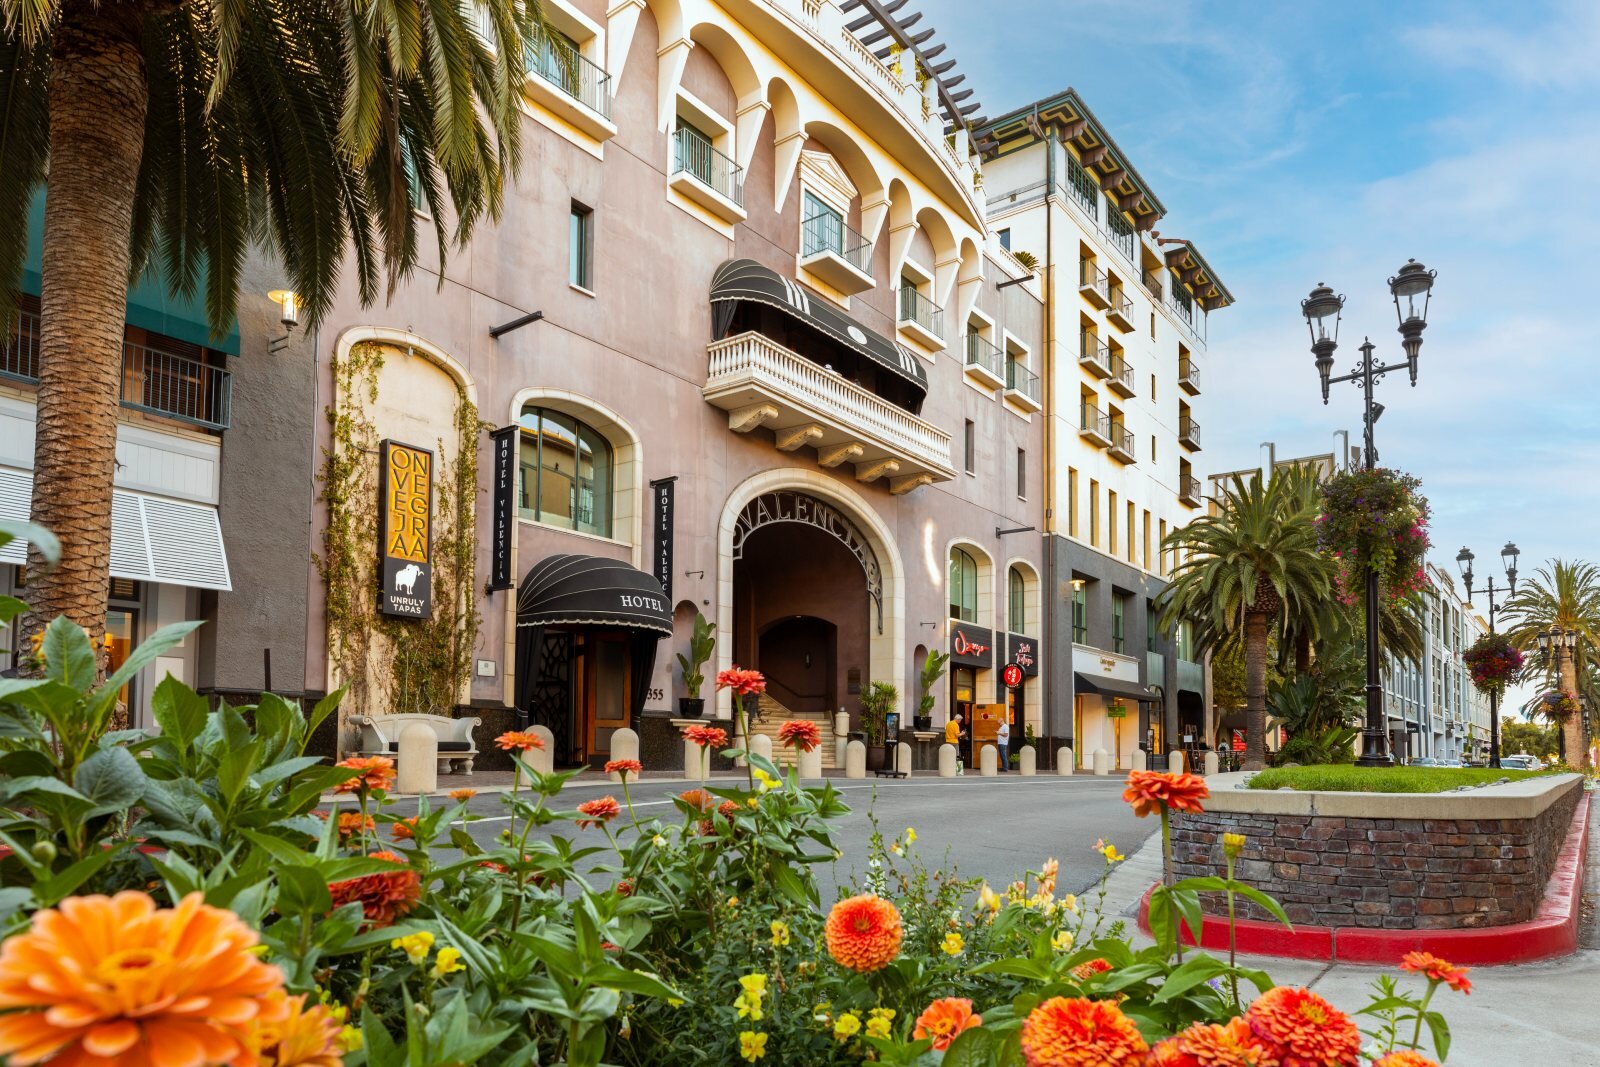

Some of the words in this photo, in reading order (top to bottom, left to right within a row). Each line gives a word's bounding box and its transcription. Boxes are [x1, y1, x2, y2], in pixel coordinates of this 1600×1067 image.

[391, 449, 411, 556] OVEJA
[410, 453, 428, 559] NEGRA
[498, 499, 506, 579] VALENCIA
[739, 492, 867, 567] VALENCIA
[390, 595, 425, 609] UNRULY
[393, 603, 422, 614] TAPAS
[620, 595, 664, 612] HOTEL
[647, 688, 664, 700] 355
